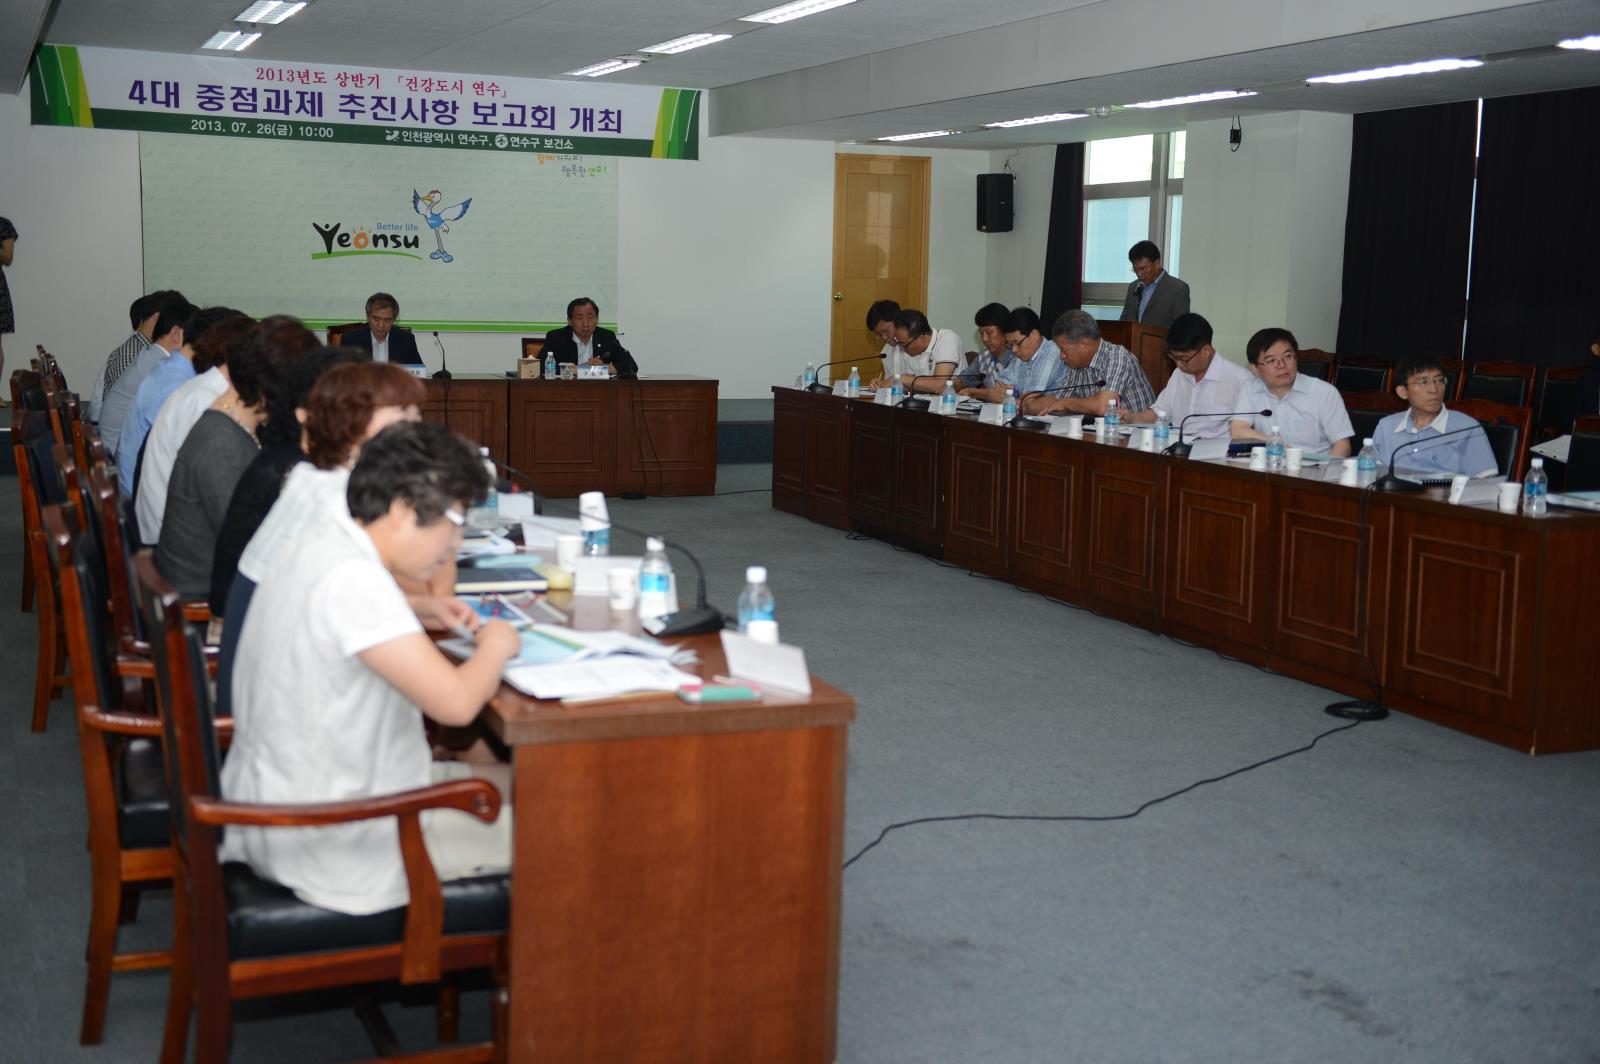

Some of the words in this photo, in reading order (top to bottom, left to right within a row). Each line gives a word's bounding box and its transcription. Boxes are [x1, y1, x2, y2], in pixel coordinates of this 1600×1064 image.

[256, 67, 327, 85] 2013년도
[335, 72, 381, 90] 상반기
[128, 79, 180, 109] 4대
[196, 83, 323, 118] 중점과제
[338, 93, 460, 126] 추진사항
[472, 101, 555, 130] 보고회
[569, 108, 622, 134] 개최
[191, 119, 226, 133] 2013.
[231, 121, 251, 134] 07.
[256, 123, 293, 137] 26(금)
[299, 126, 334, 138] 10:00
[401, 130, 454, 145] 인천광역시
[510, 136, 541, 149] 연수구
[543, 138, 574, 150] 보건소
[376, 222, 403, 232] Better
[405, 223, 419, 232] life
[312, 222, 420, 255] Yeonsu
